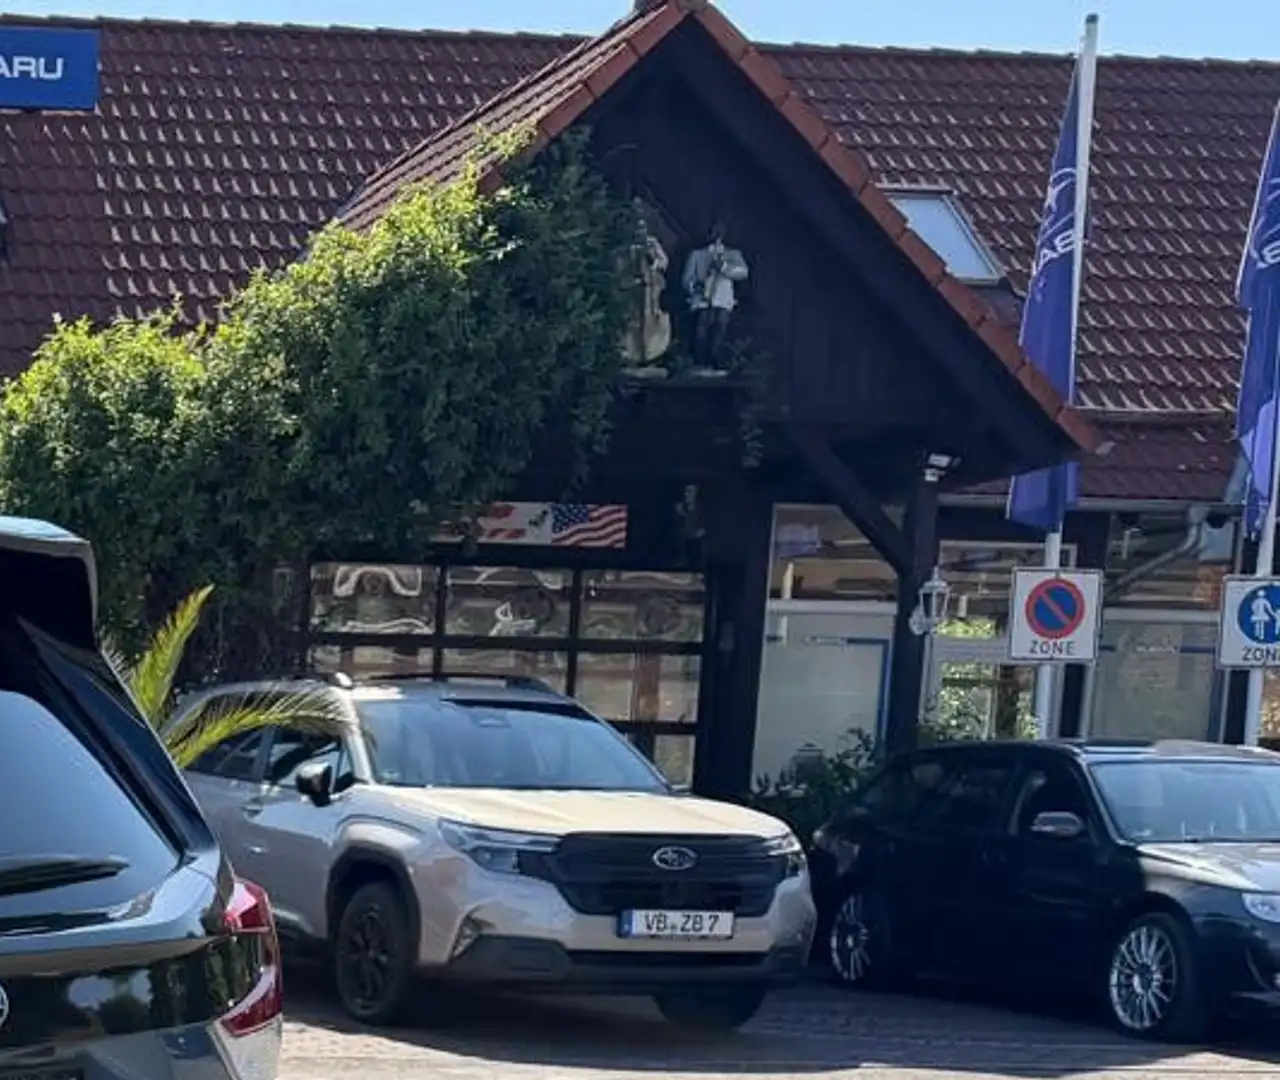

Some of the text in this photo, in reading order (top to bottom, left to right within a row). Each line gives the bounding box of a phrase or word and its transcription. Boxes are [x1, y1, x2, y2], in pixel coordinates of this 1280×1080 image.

[1028, 640, 1077, 656] ZONE
[1241, 647, 1280, 661] ZON
[707, 913, 721, 933] 7
